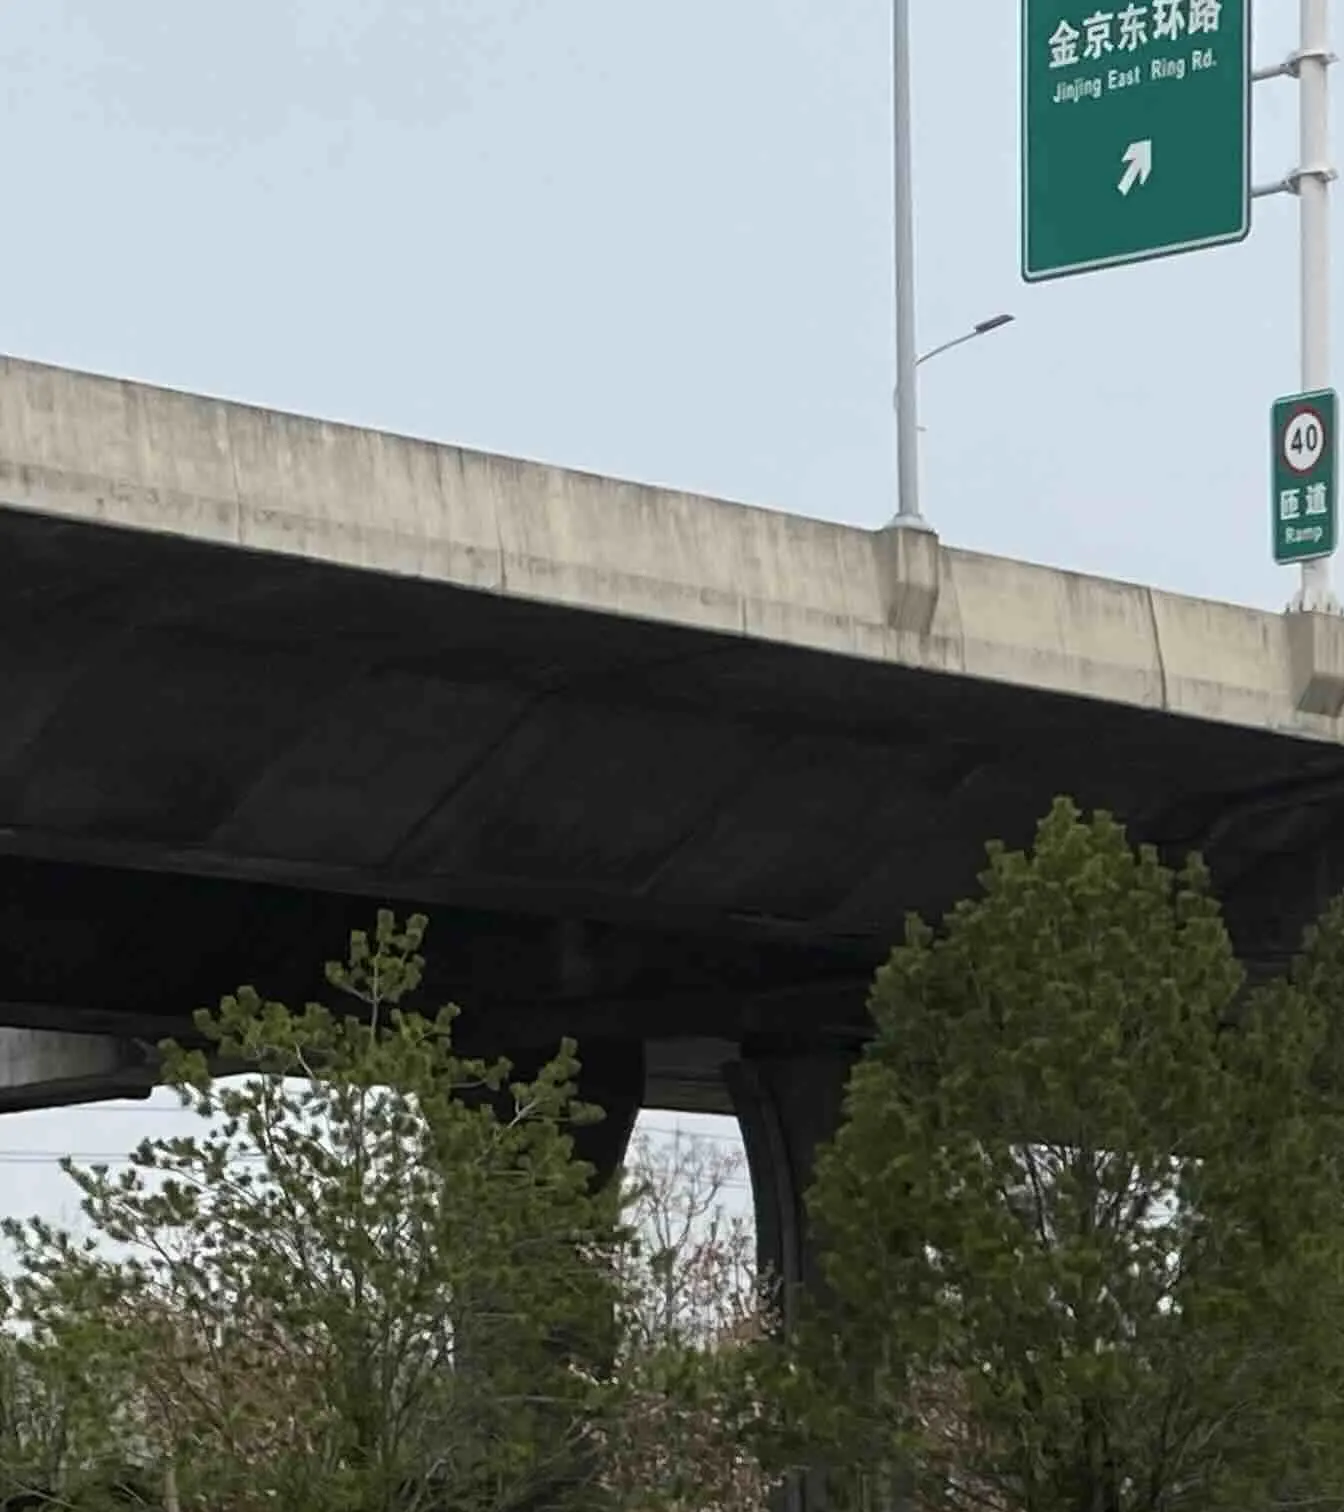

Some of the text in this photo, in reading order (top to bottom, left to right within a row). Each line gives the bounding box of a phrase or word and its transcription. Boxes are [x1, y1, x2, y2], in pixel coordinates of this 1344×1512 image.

[1048, 0, 1222, 68] 金京东环路
[1053, 49, 1217, 103] Jinjing East Ring Rd.
[1291, 424, 1318, 454] 40
